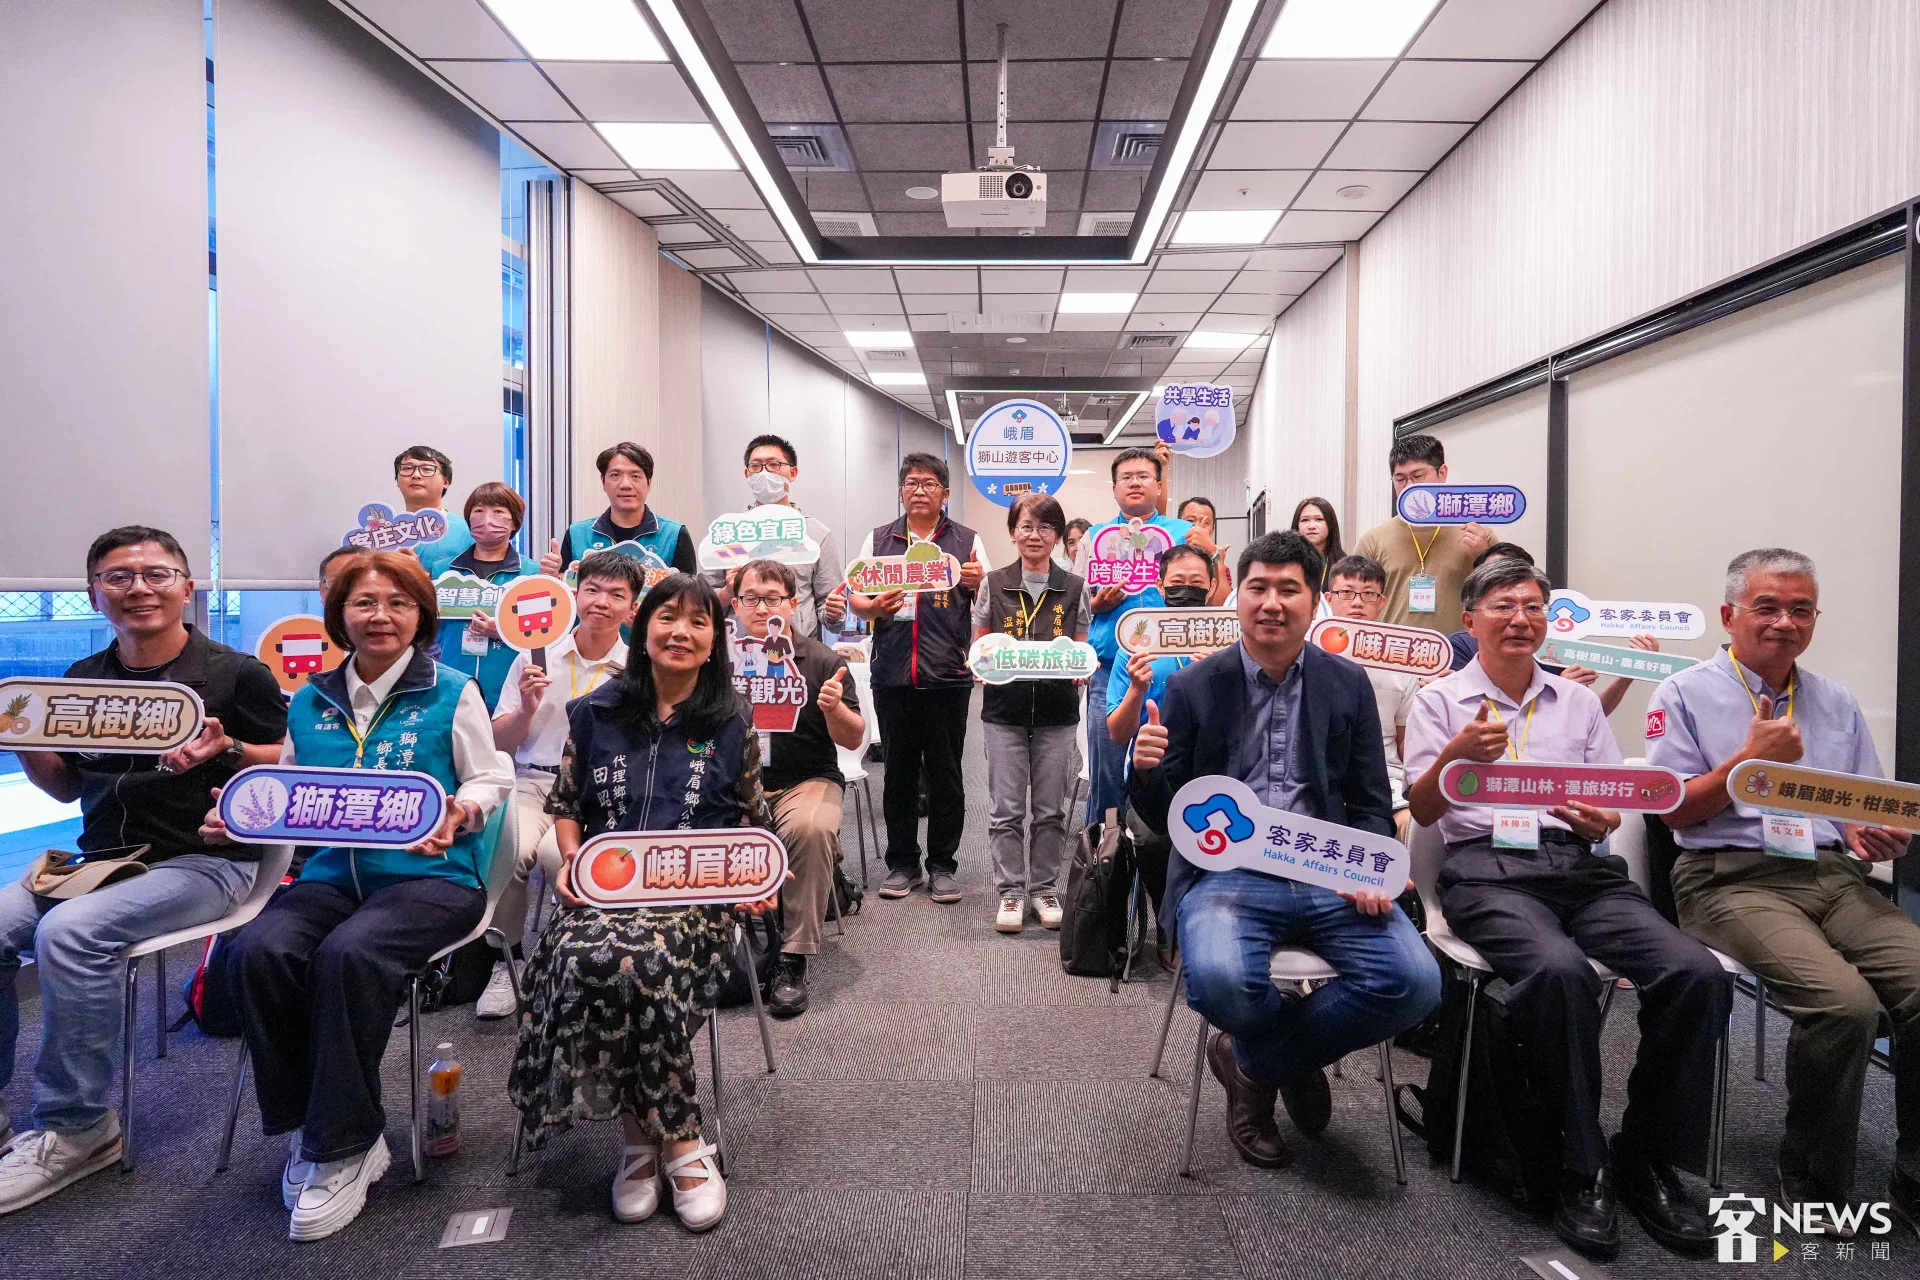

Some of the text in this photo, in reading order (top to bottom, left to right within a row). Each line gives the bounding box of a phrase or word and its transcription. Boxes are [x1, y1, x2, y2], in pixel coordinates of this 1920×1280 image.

[1164, 386, 1230, 407] 共學生活
[1003, 426, 1034, 440] 峨眉
[978, 450, 1059, 464] 獅山遊客中心
[1436, 492, 1516, 518] 獅潭鄉
[712, 518, 803, 545] 綠色宜居
[860, 561, 947, 586] 休閒農業
[1089, 560, 1161, 584] 跨齡生
[1600, 608, 1692, 624] 客家委員會
[1160, 619, 1241, 648] 高樹鄉
[1353, 630, 1442, 669] 峨眉鄉
[994, 650, 1088, 670] 低碳旅遊
[45, 694, 184, 741] 高樹鄉
[396, 731, 418, 771] 獅潭
[612, 754, 628, 816] 代理鄉長
[677, 759, 706, 831] 峨眉鄉公所
[1777, 780, 1920, 819] 峨眉湖光·柑樂茶
[286, 783, 426, 832] 獅潭鄉
[644, 843, 769, 889] 峨眉鄉
[1266, 825, 1396, 874] 客家委員會
[1263, 847, 1385, 887] Hakka Affairs Council
